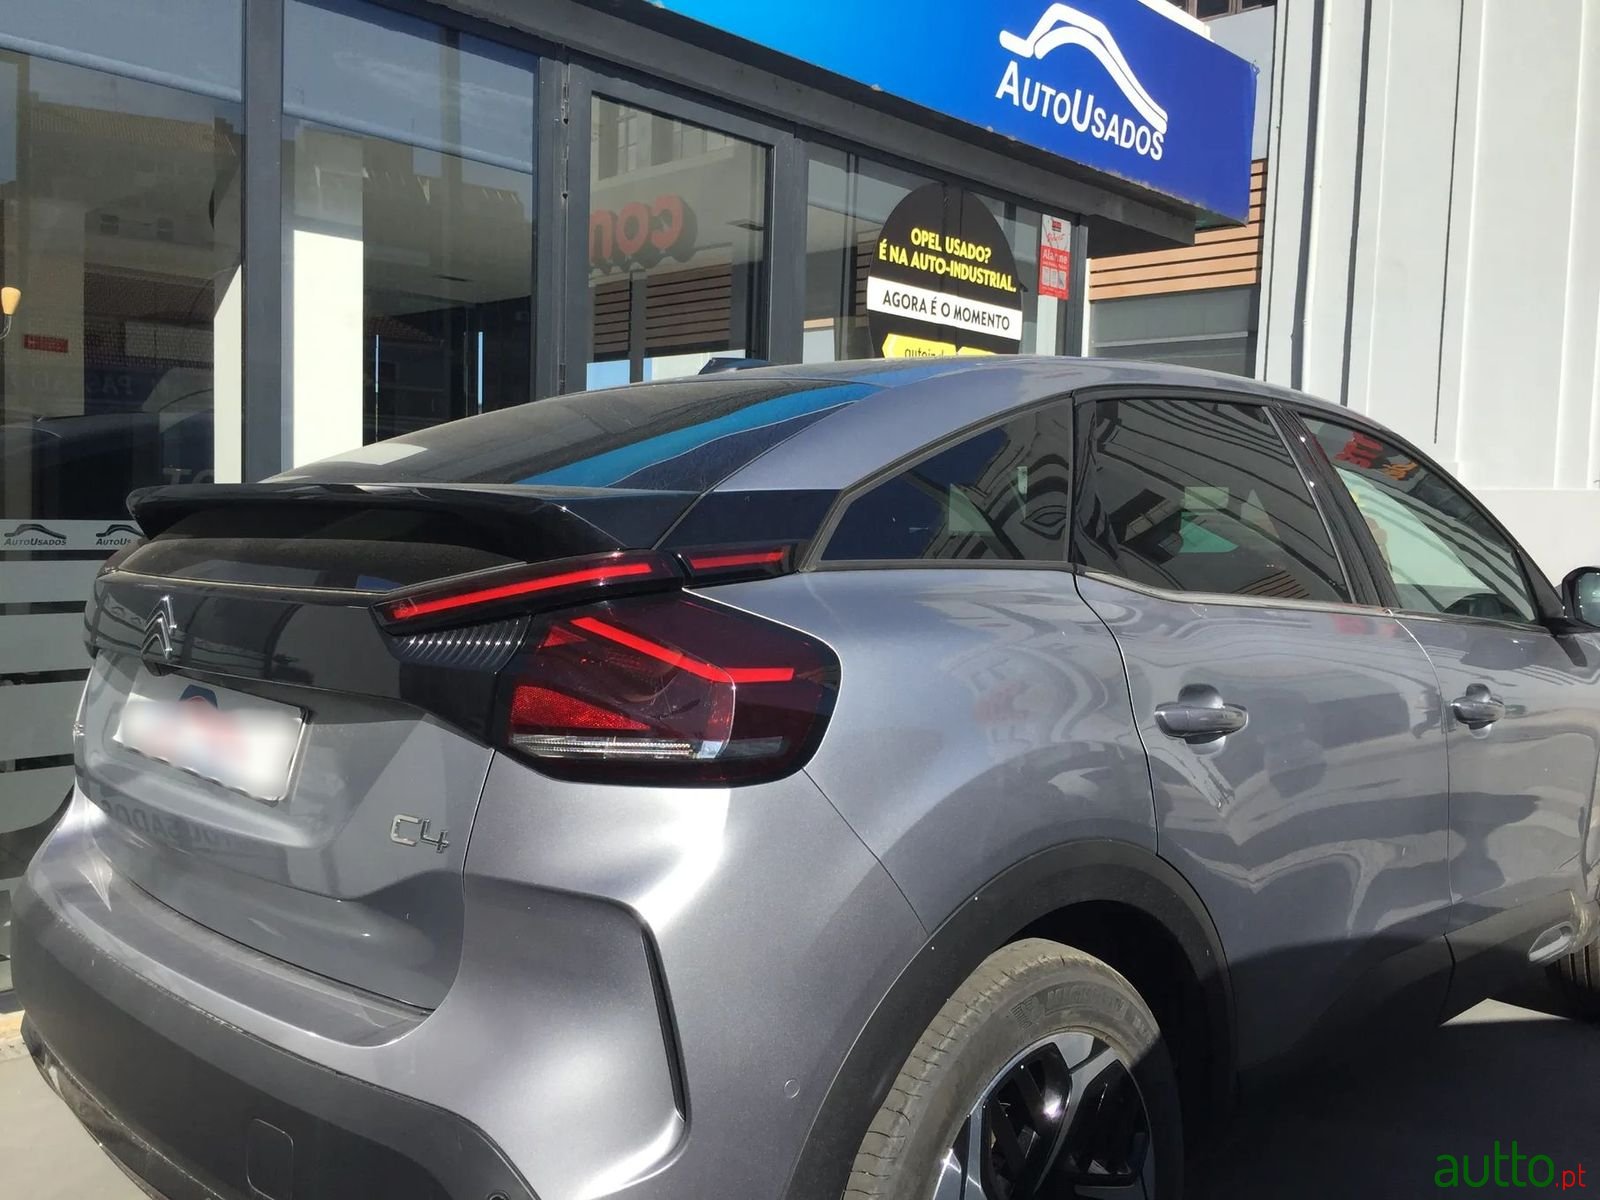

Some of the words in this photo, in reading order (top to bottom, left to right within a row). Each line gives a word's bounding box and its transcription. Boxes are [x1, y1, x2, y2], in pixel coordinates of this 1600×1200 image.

[878, 238, 888, 261] É
[889, 244, 909, 267] NA
[910, 251, 1017, 293] AUTO-INDUSTRIAL.
[910, 227, 942, 252] OPEL
[945, 235, 993, 264] USADO?
[883, 289, 928, 315] AGORA
[930, 296, 938, 317] É
[940, 302, 951, 318] O
[953, 304, 1011, 331] MOMENTO
[391, 814, 449, 854] C4
